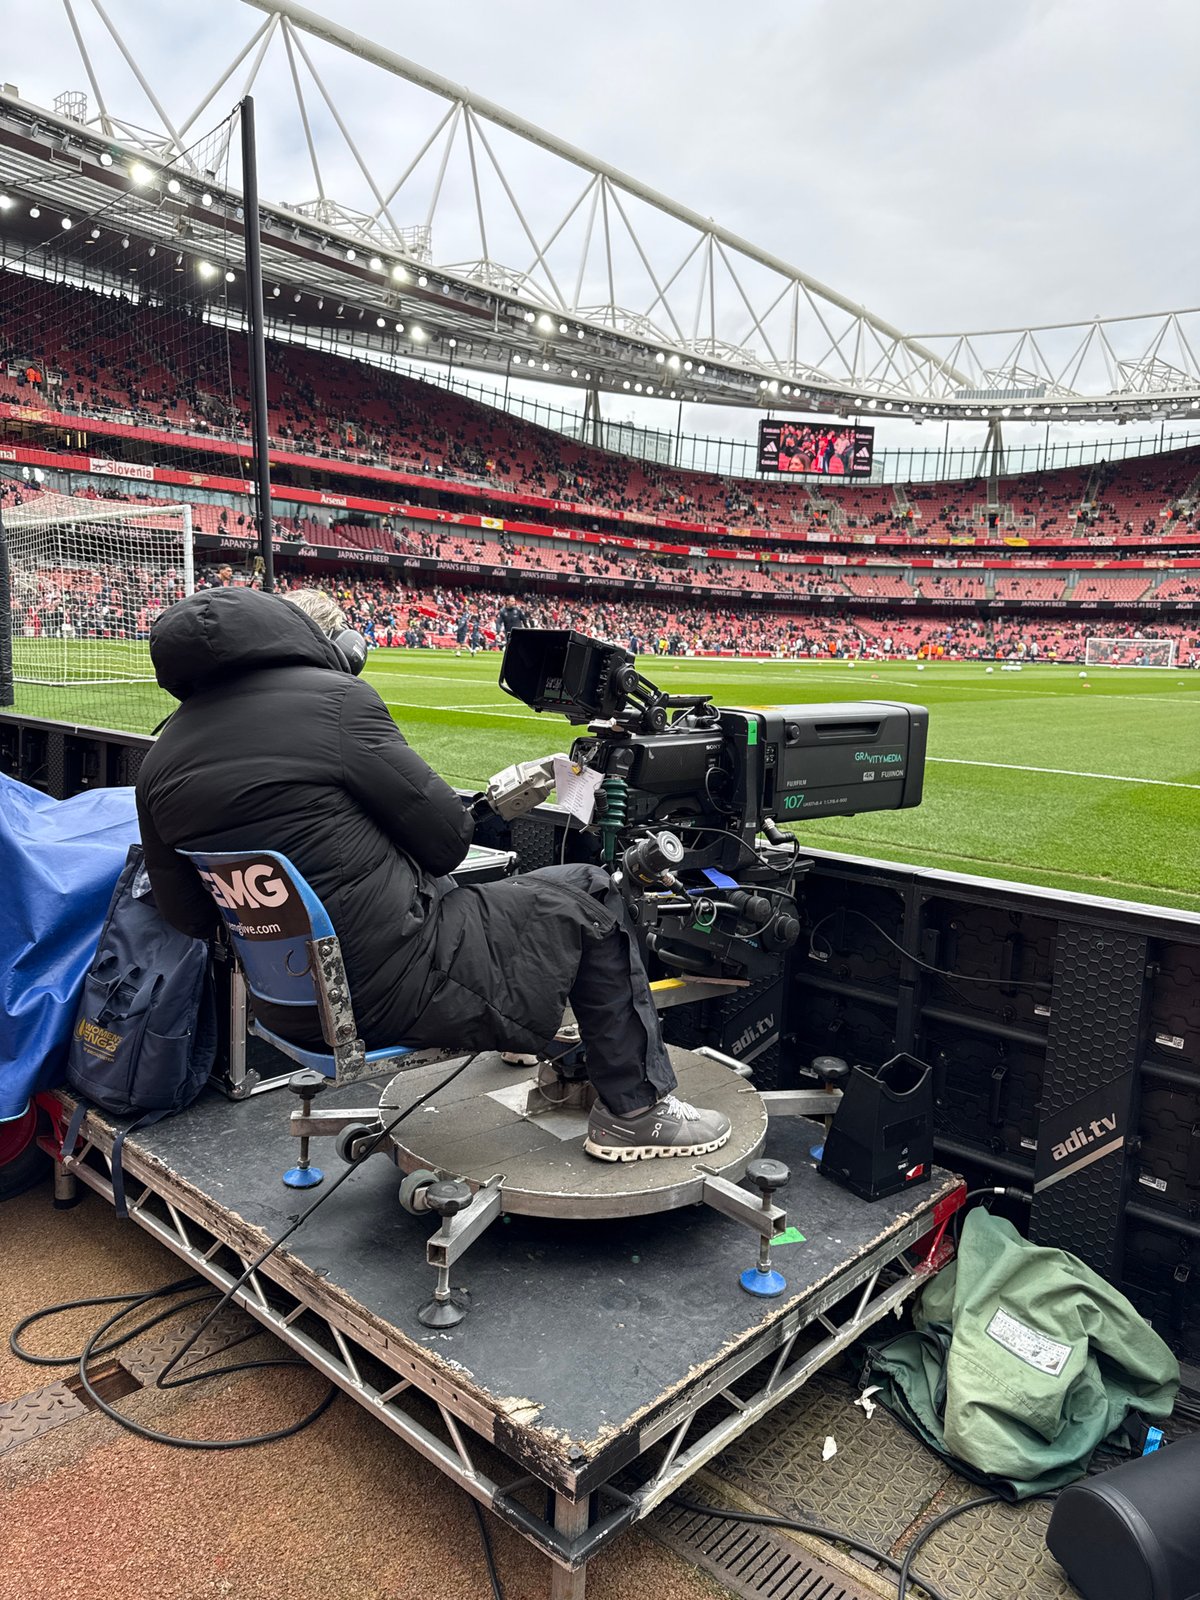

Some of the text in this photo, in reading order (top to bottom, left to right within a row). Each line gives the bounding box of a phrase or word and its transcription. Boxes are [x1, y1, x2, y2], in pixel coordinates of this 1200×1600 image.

[106, 462, 152, 479] Slovenia
[321, 494, 347, 507] Arsenal
[220, 539, 252, 550] JAPAN'S
[337, 550, 364, 561] JAPAN'S
[373, 555, 389, 563] BEER
[437, 562, 459, 571] JAPAN'S
[961, 560, 984, 568] Arsenal
[786, 779, 807, 787] FUJIFILM
[783, 794, 805, 809] 107
[198, 864, 289, 909] EMG
[731, 1013, 775, 1055] adi.tv
[1050, 1112, 1117, 1161] adi.tv
